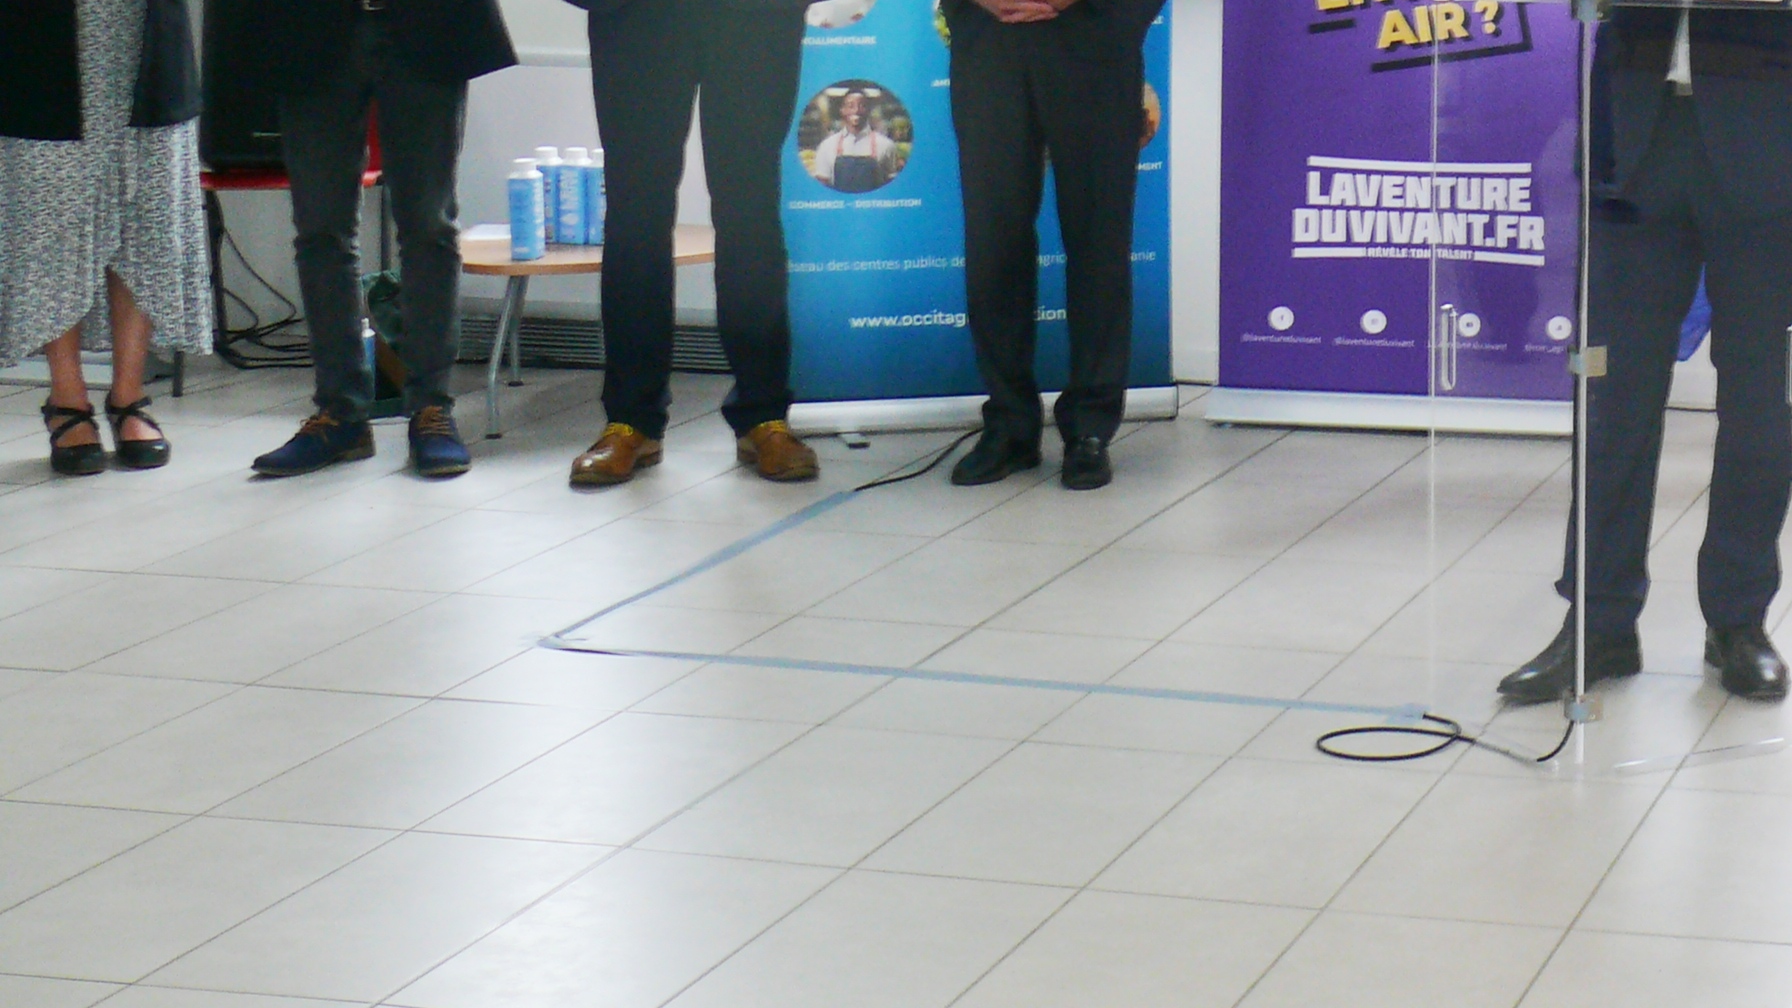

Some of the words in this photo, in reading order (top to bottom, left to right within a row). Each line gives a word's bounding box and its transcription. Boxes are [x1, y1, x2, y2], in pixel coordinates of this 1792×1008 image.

[1377, 3, 1470, 49] AIR
[1475, 0, 1499, 35] ?
[1306, 170, 1532, 212] LAVENTURE
[1292, 207, 1545, 251] DUVIVANT.FR
[827, 259, 850, 271] des
[852, 258, 900, 271] centres
[903, 255, 949, 273] publics
[1410, 248, 1432, 259] TON
[1436, 249, 1473, 260] TALENT
